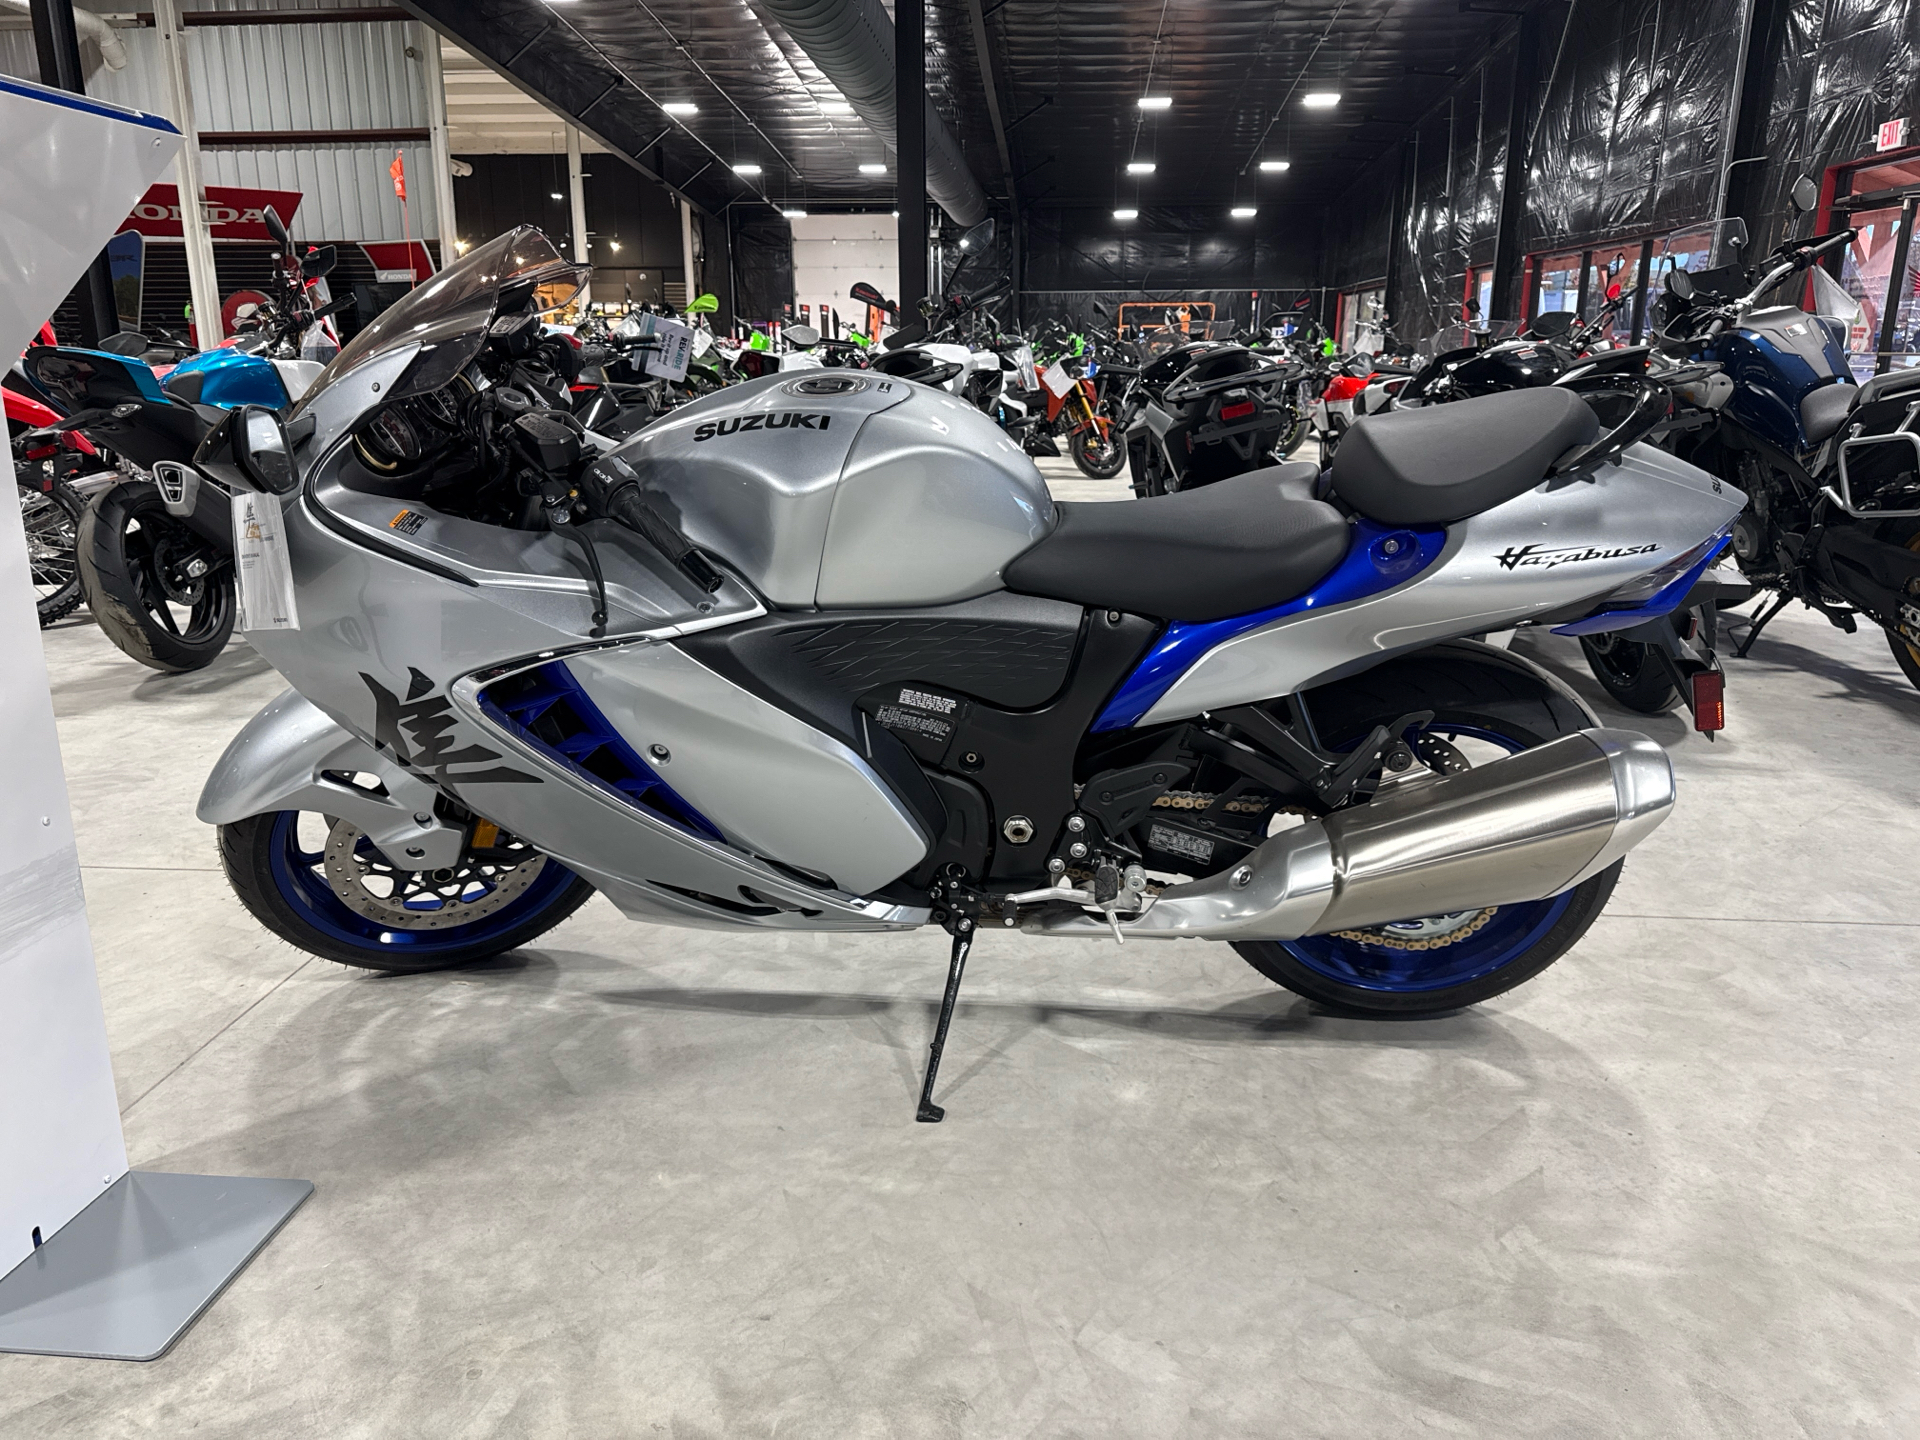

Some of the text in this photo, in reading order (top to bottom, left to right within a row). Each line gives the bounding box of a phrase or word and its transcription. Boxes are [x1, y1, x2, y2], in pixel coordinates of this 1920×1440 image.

[1881, 120, 1900, 147] EXIT
[128, 203, 266, 223] ODA
[693, 412, 831, 443] SUZUKI
[1492, 542, 1663, 571] Hayabusa
